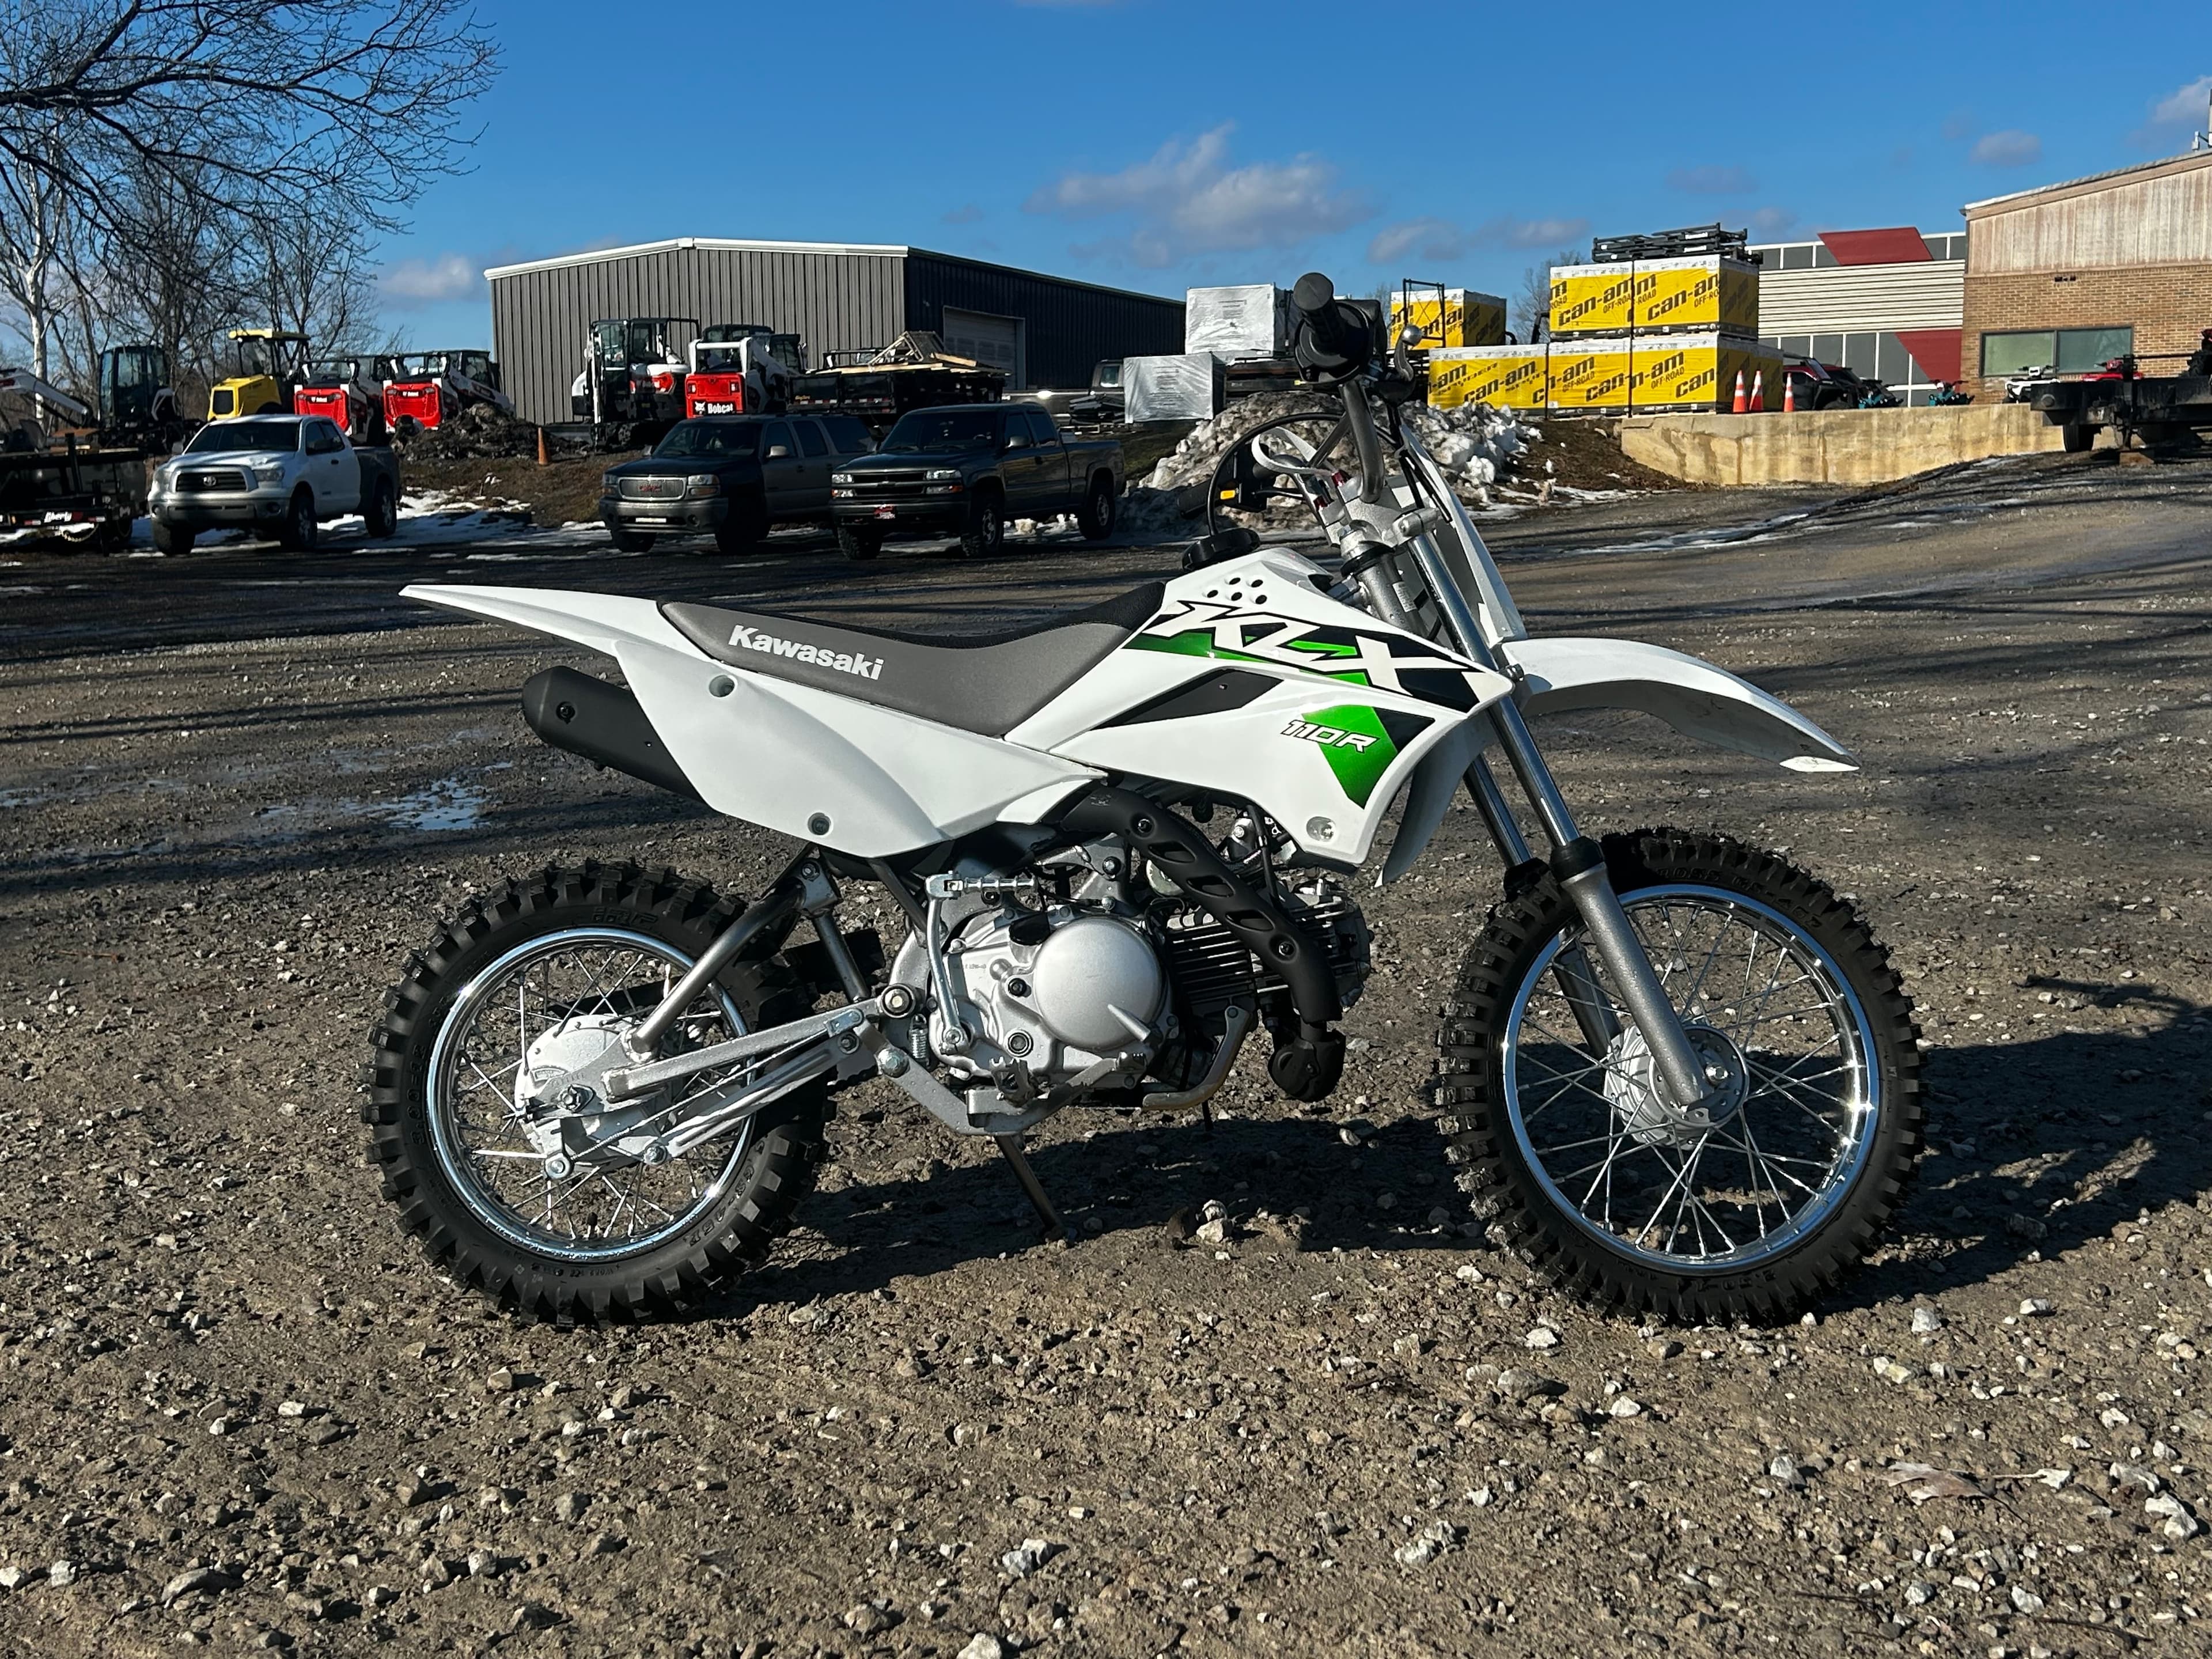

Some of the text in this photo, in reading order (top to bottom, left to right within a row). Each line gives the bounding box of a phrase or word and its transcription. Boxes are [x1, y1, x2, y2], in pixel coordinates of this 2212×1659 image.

[1562, 371, 1595, 392] OFF-ROAD
[1651, 366, 1685, 389] OFF-ROAD
[707, 403, 733, 414] Bobcat
[728, 624, 885, 680] Kawasaki
[1281, 719, 1381, 753] 110R
